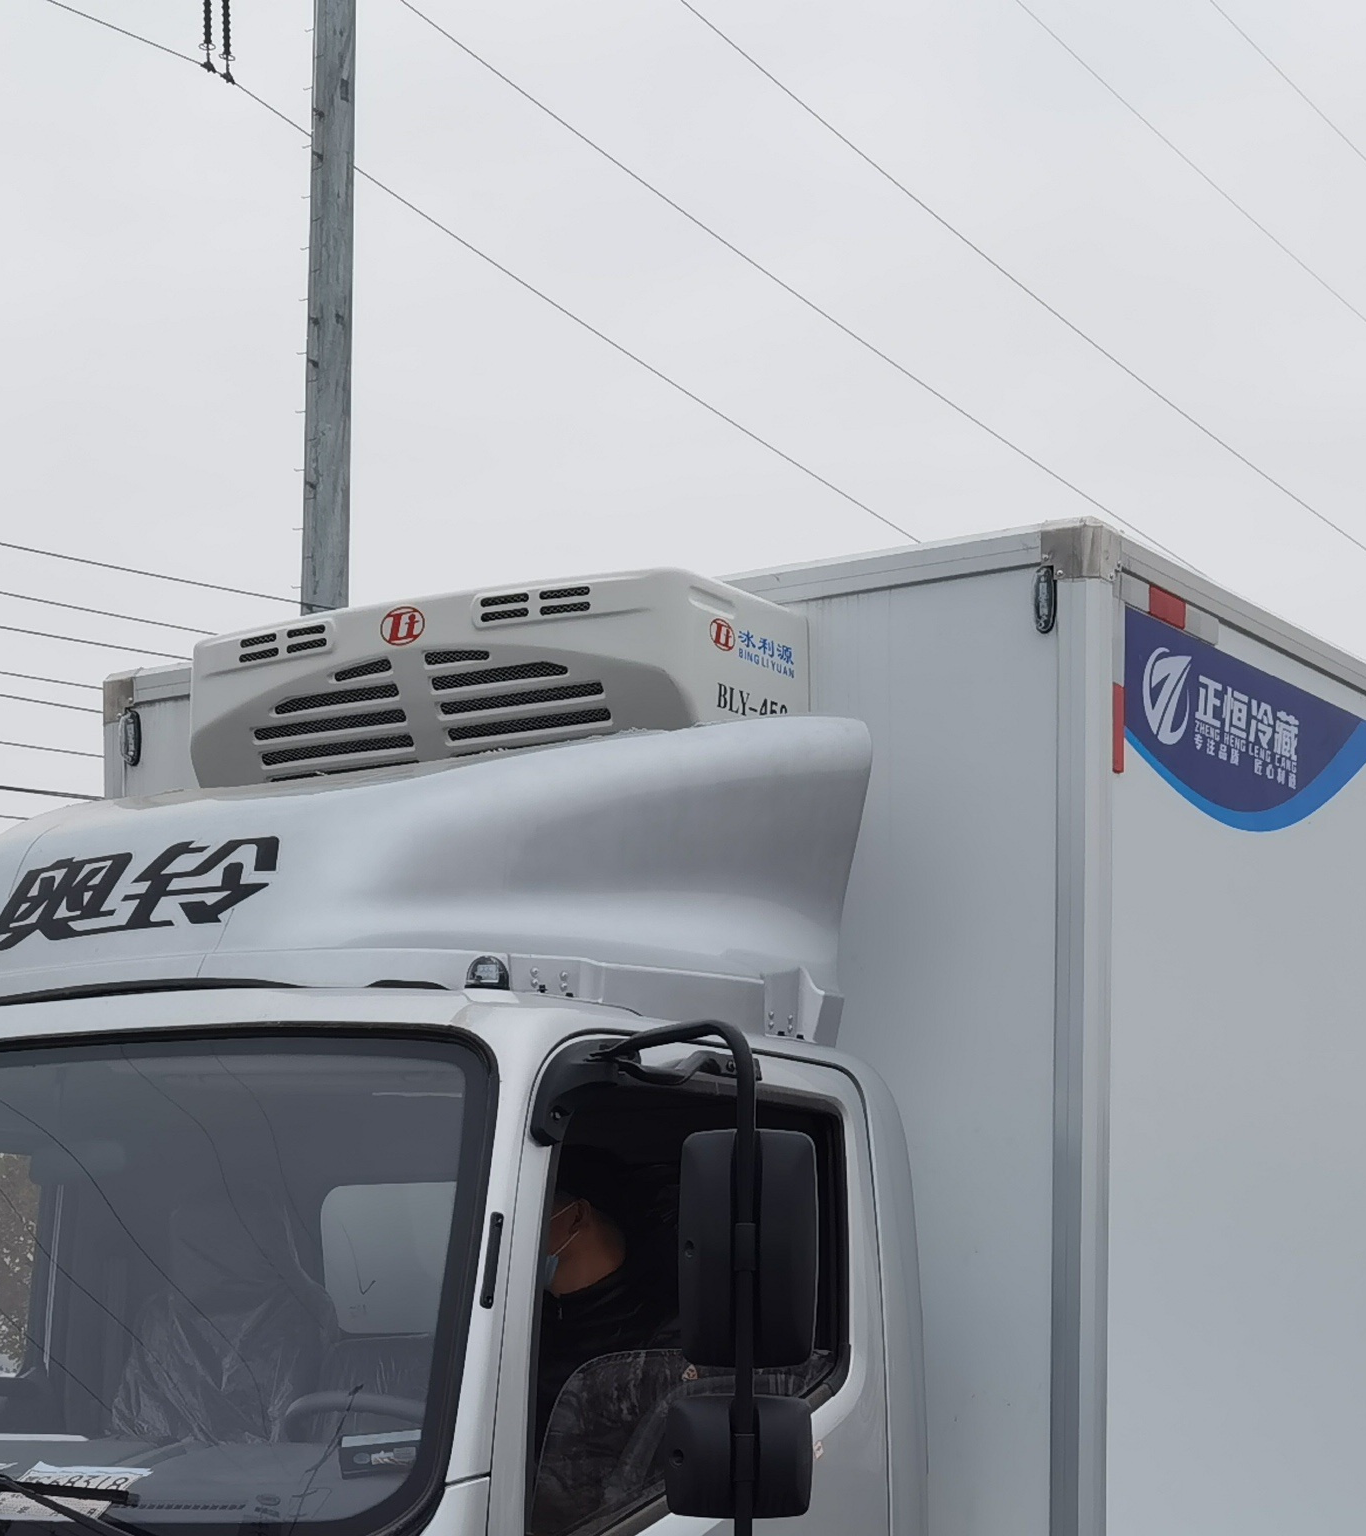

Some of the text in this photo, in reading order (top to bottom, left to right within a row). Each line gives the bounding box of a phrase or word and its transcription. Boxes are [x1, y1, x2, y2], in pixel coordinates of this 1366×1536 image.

[737, 630, 795, 666] 冰利源
[1194, 674, 1300, 762] 正恒冷藏
[1194, 719, 1298, 774] ZHENG HENG LENG CANG
